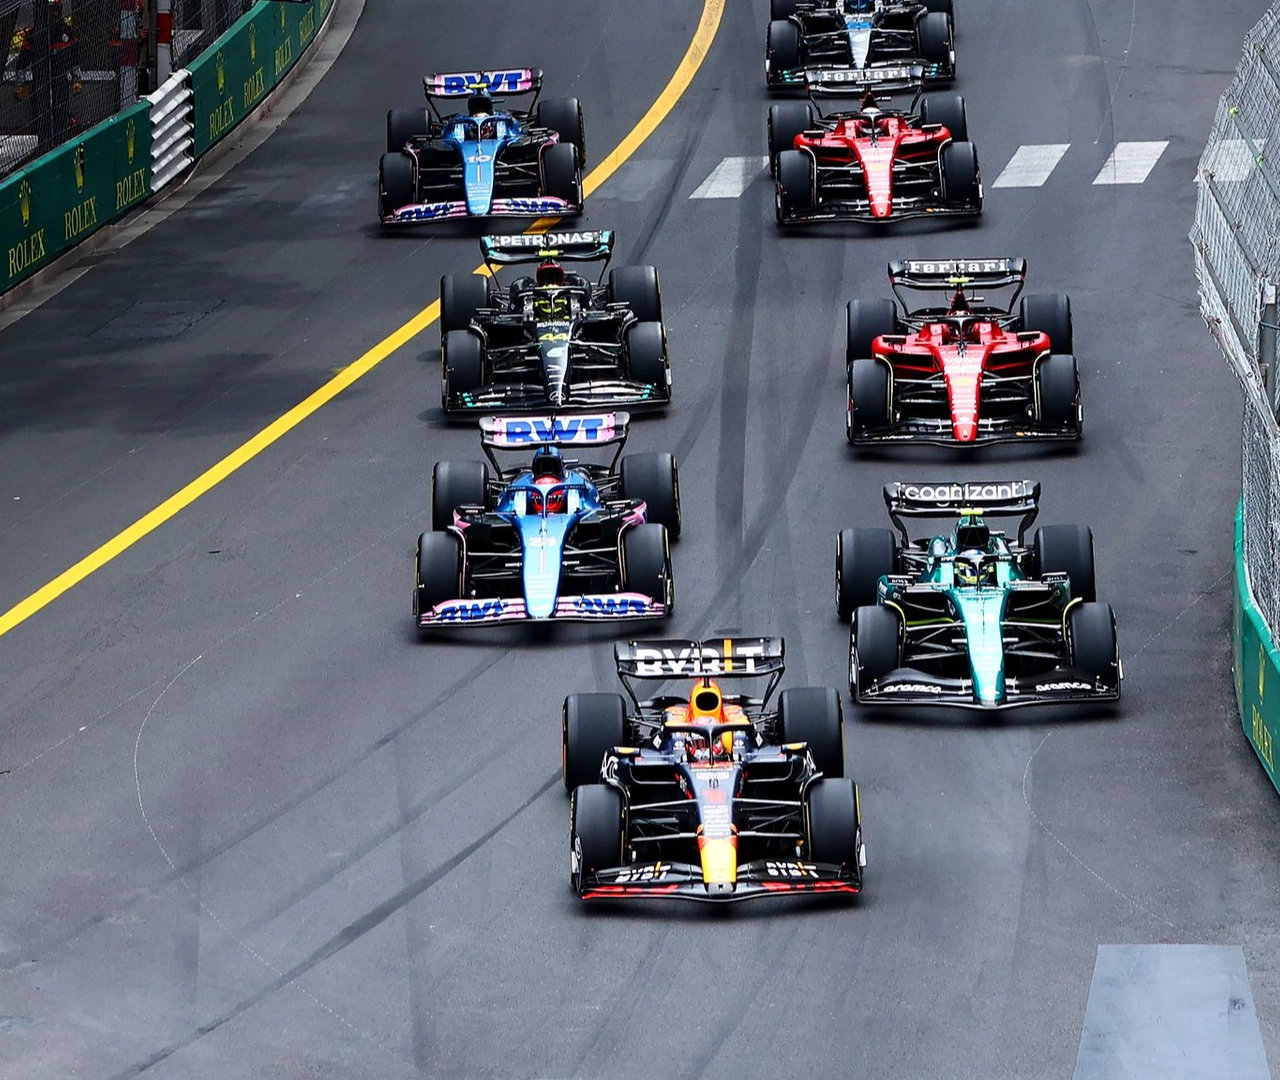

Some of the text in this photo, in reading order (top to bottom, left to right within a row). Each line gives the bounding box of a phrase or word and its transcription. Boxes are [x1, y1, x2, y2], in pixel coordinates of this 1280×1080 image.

[276, 38, 292, 76] ROLEX
[444, 73, 523, 93] BWT
[821, 68, 907, 82] Ferrari
[245, 69, 265, 109] ROLEX
[209, 97, 235, 140] ROLEX
[467, 155, 491, 163] 10
[115, 168, 147, 211] ROLEX
[64, 197, 98, 242] ROLEX
[501, 232, 594, 247] PETRONAS
[8, 228, 47, 278] ROLEX
[909, 260, 1007, 274] Ferrari
[539, 333, 568, 341] 44
[506, 419, 603, 443] BWT
[904, 483, 1020, 507] cognizant
[635, 639, 763, 675] BYBIT
[884, 684, 941, 693] aramco
[1036, 682, 1091, 692] aramco
